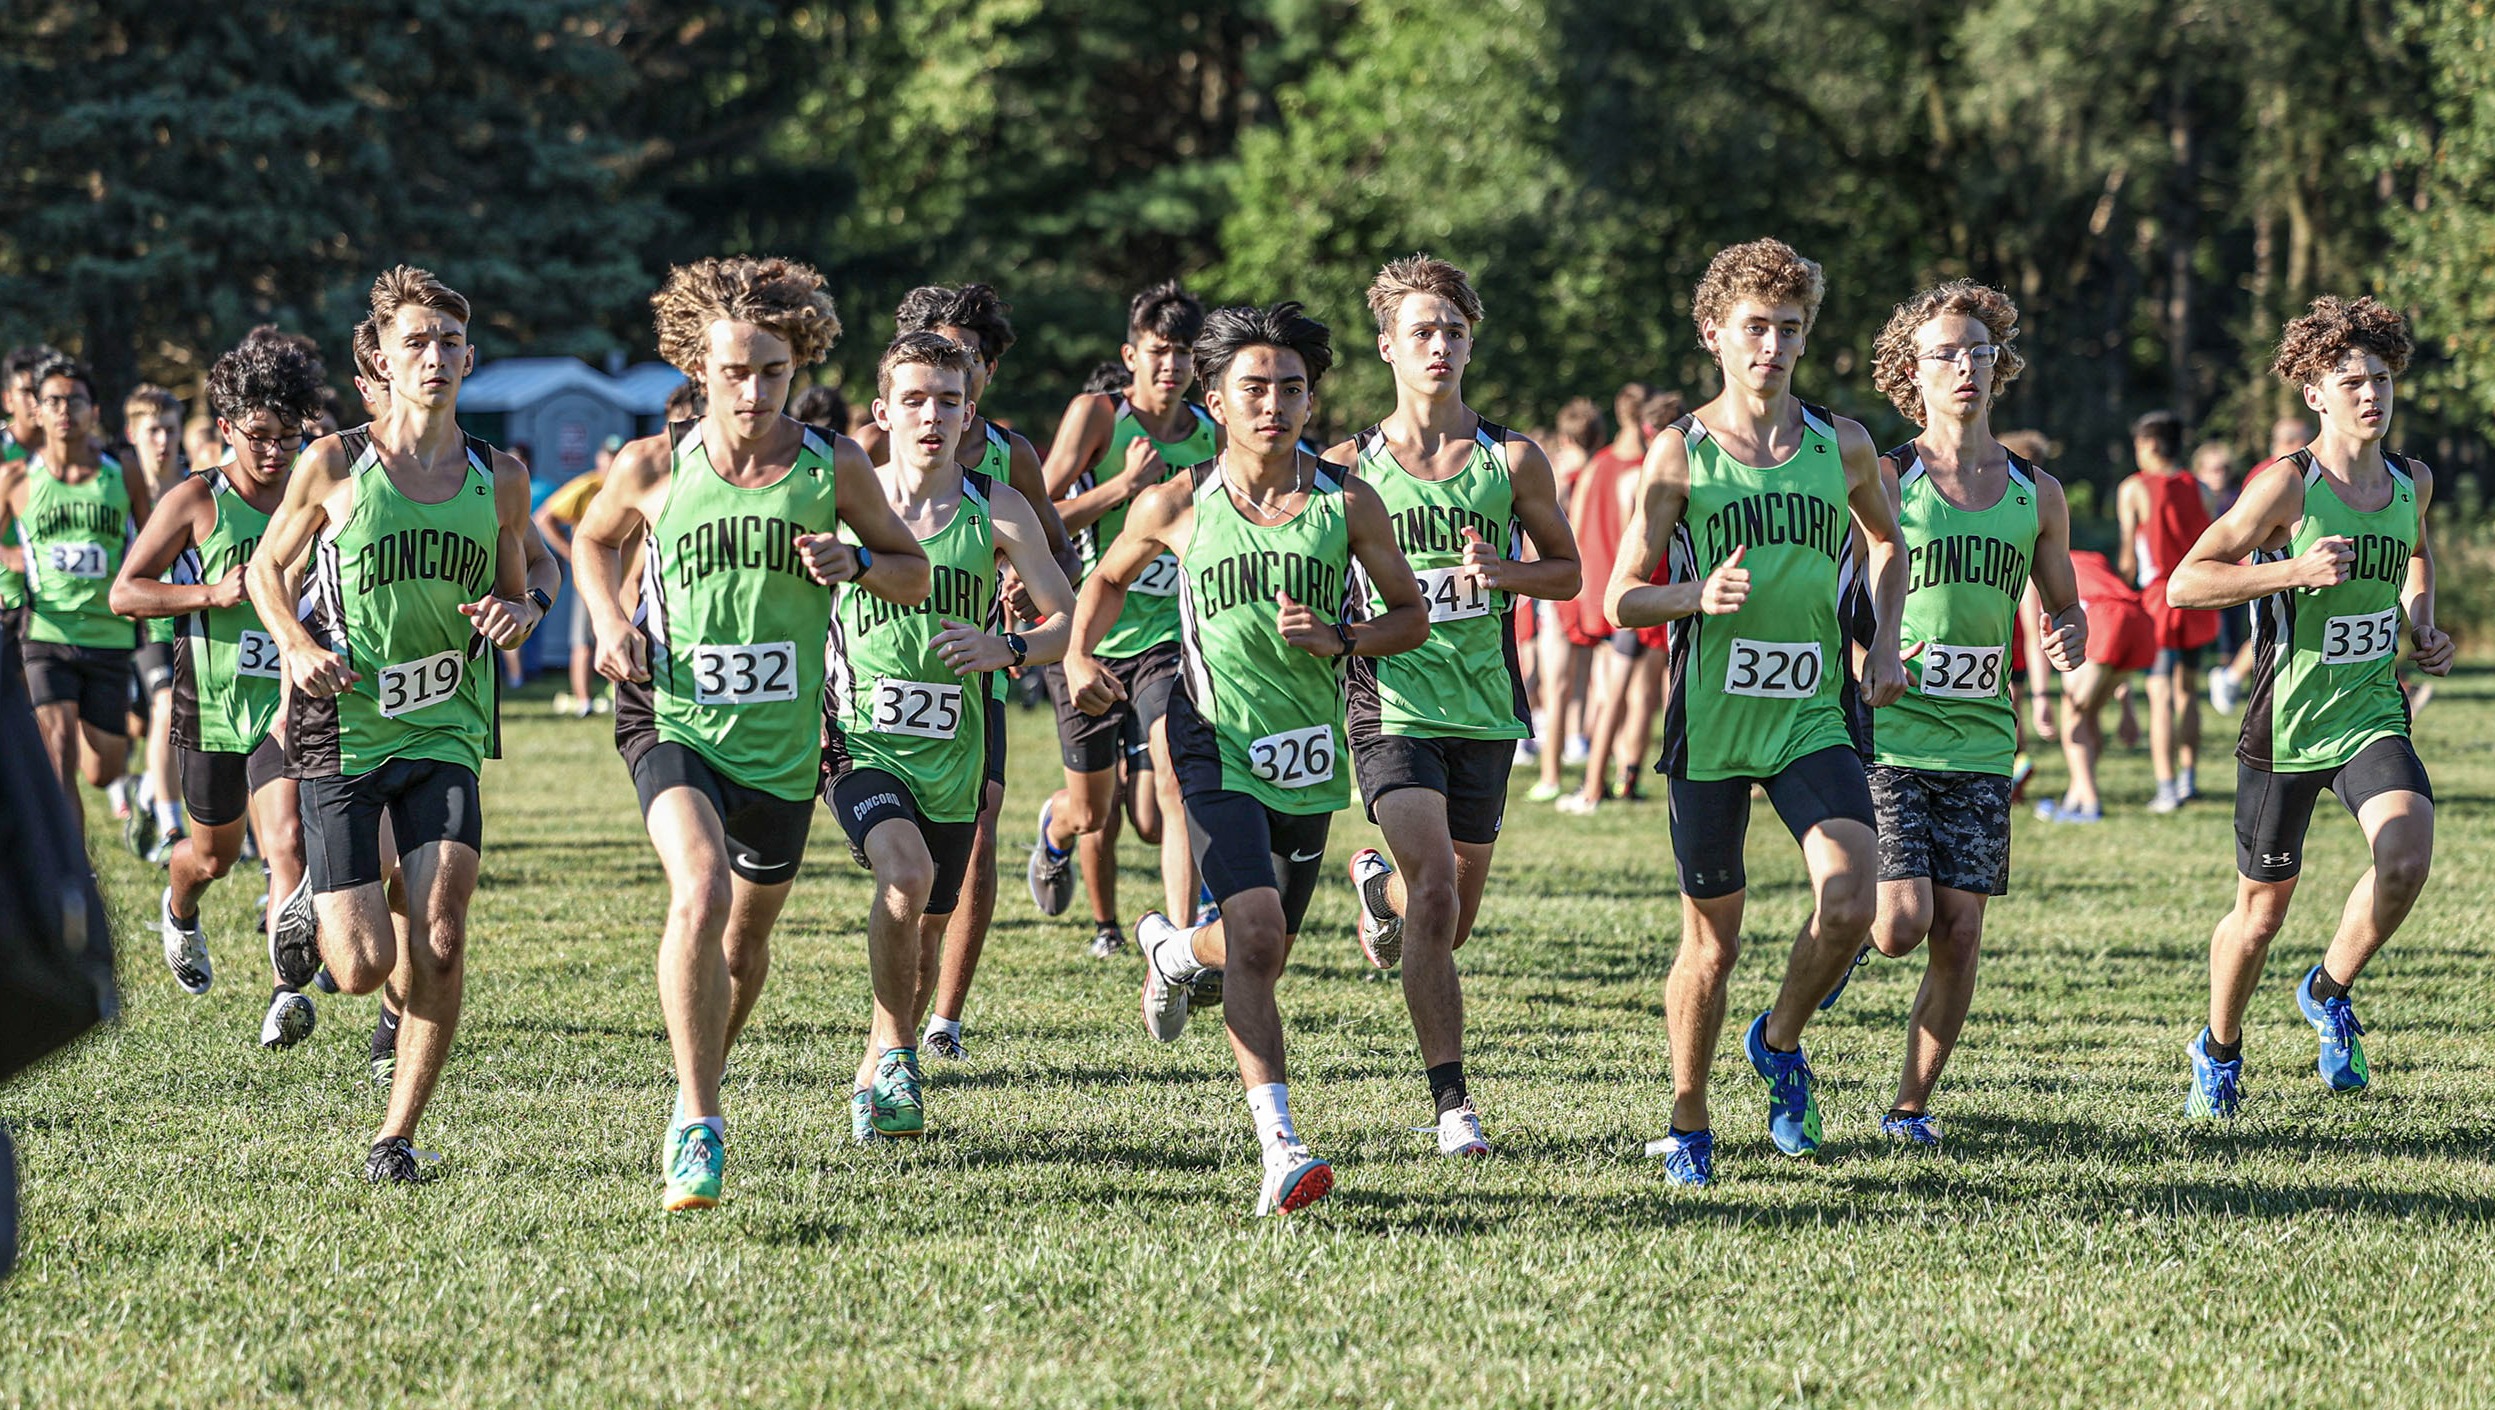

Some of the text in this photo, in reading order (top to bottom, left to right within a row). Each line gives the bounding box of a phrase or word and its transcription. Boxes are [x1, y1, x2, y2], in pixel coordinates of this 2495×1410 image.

[38, 502, 121, 540] CONCORD
[1390, 506, 1499, 556] ONCORD
[1706, 492, 1838, 569] CONCORD
[53, 546, 100, 572] 321
[359, 529, 488, 596] CONCORD
[677, 516, 821, 589] CONCOR
[1131, 559, 1178, 590] 27
[1907, 535, 2026, 602] CONCORD
[2345, 534, 2411, 592] NCORD
[1201, 551, 1336, 620] CONCORD
[242, 636, 281, 671] 32
[2327, 615, 2393, 657] 335
[385, 658, 459, 710] 319
[700, 651, 789, 696] 332
[1732, 648, 1818, 691] 320
[1926, 651, 1999, 690] 328
[879, 687, 960, 731] 325
[1256, 734, 1330, 781] 326
[853, 792, 901, 822] CONCORD
